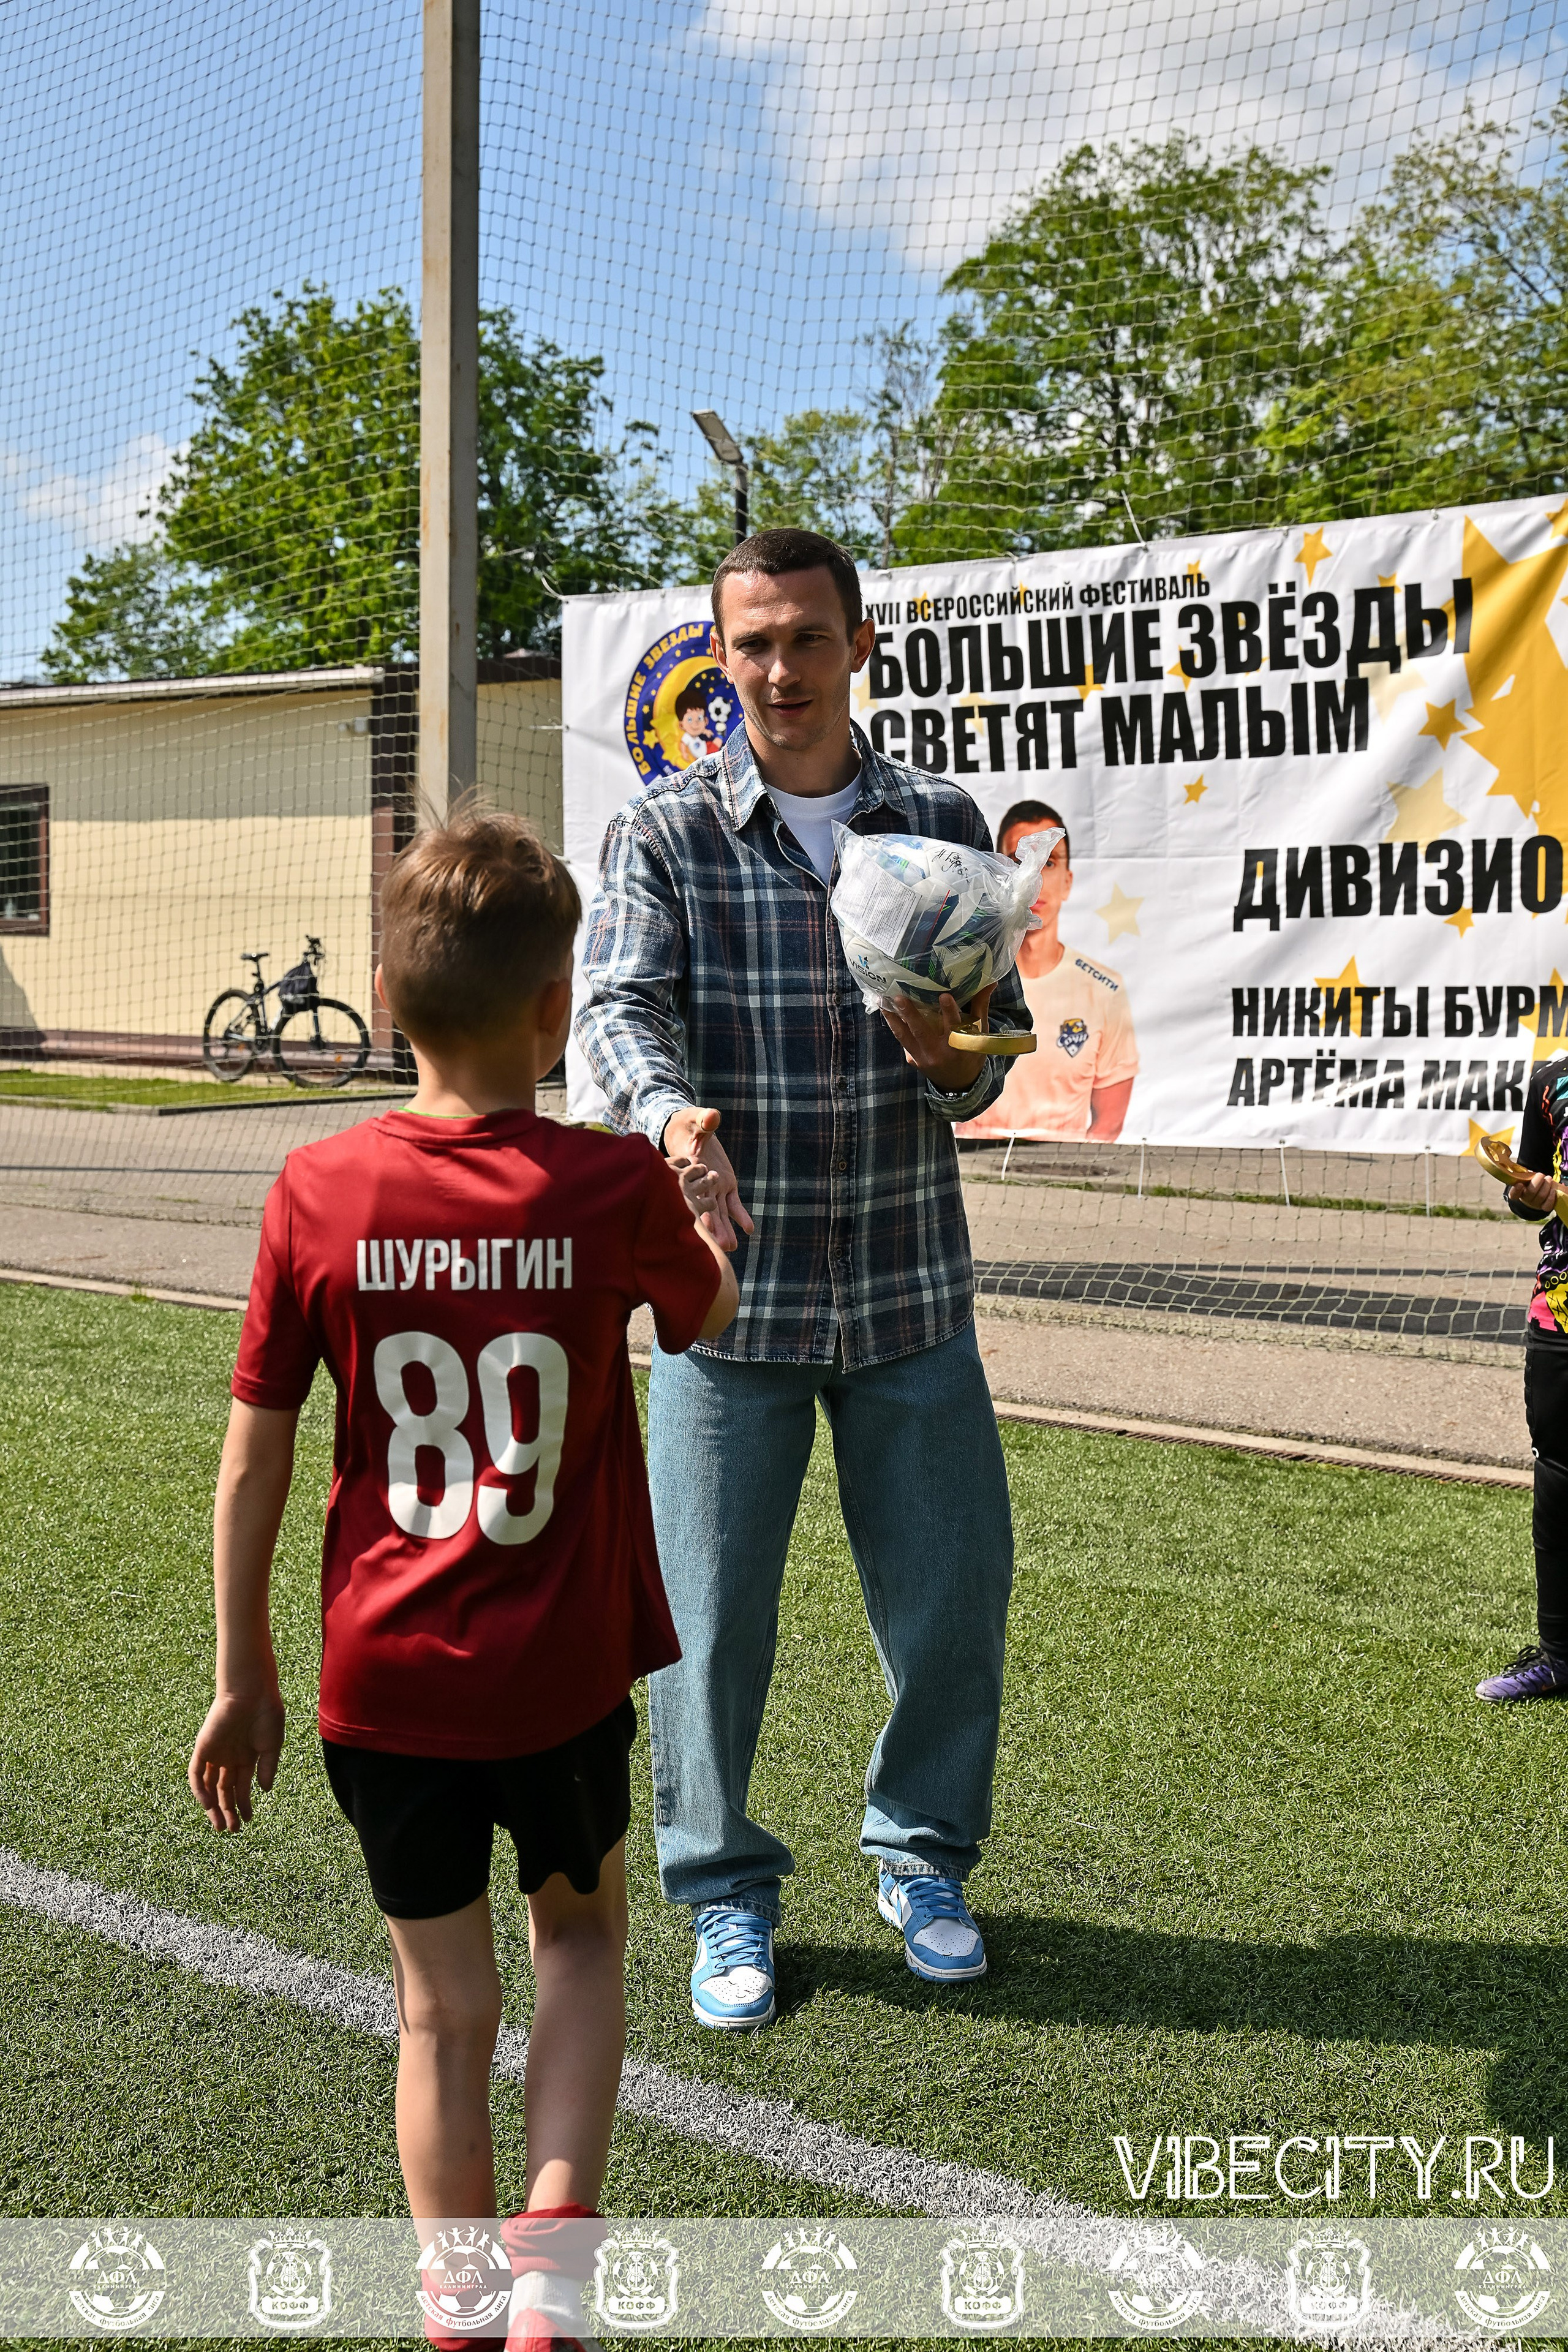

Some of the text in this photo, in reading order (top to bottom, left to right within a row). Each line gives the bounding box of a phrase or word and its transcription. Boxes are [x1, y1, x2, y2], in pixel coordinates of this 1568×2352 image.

[865, 573, 1210, 625] XVII ВСЕРОССИЙСКИЙ ФЕСТИВАЛЬ
[869, 578, 1473, 699] БОЛЬШИЕ ЗВЁЗДЫ
[626, 624, 704, 775] БОЛЬШИЕ ЗВЕЗДЫ
[870, 677, 1370, 774] СВЕТЯТ МАЛЫМ
[848, 956, 887, 984] VISION
[1075, 959, 1119, 991] БЕТСИТИ
[1232, 987, 1430, 1038] НИКИТЫ
[1227, 1049, 1552, 1112] АРТЁМА МАК
[356, 1237, 573, 1291] ШУРЫГИН
[374, 1331, 569, 1545] 89
